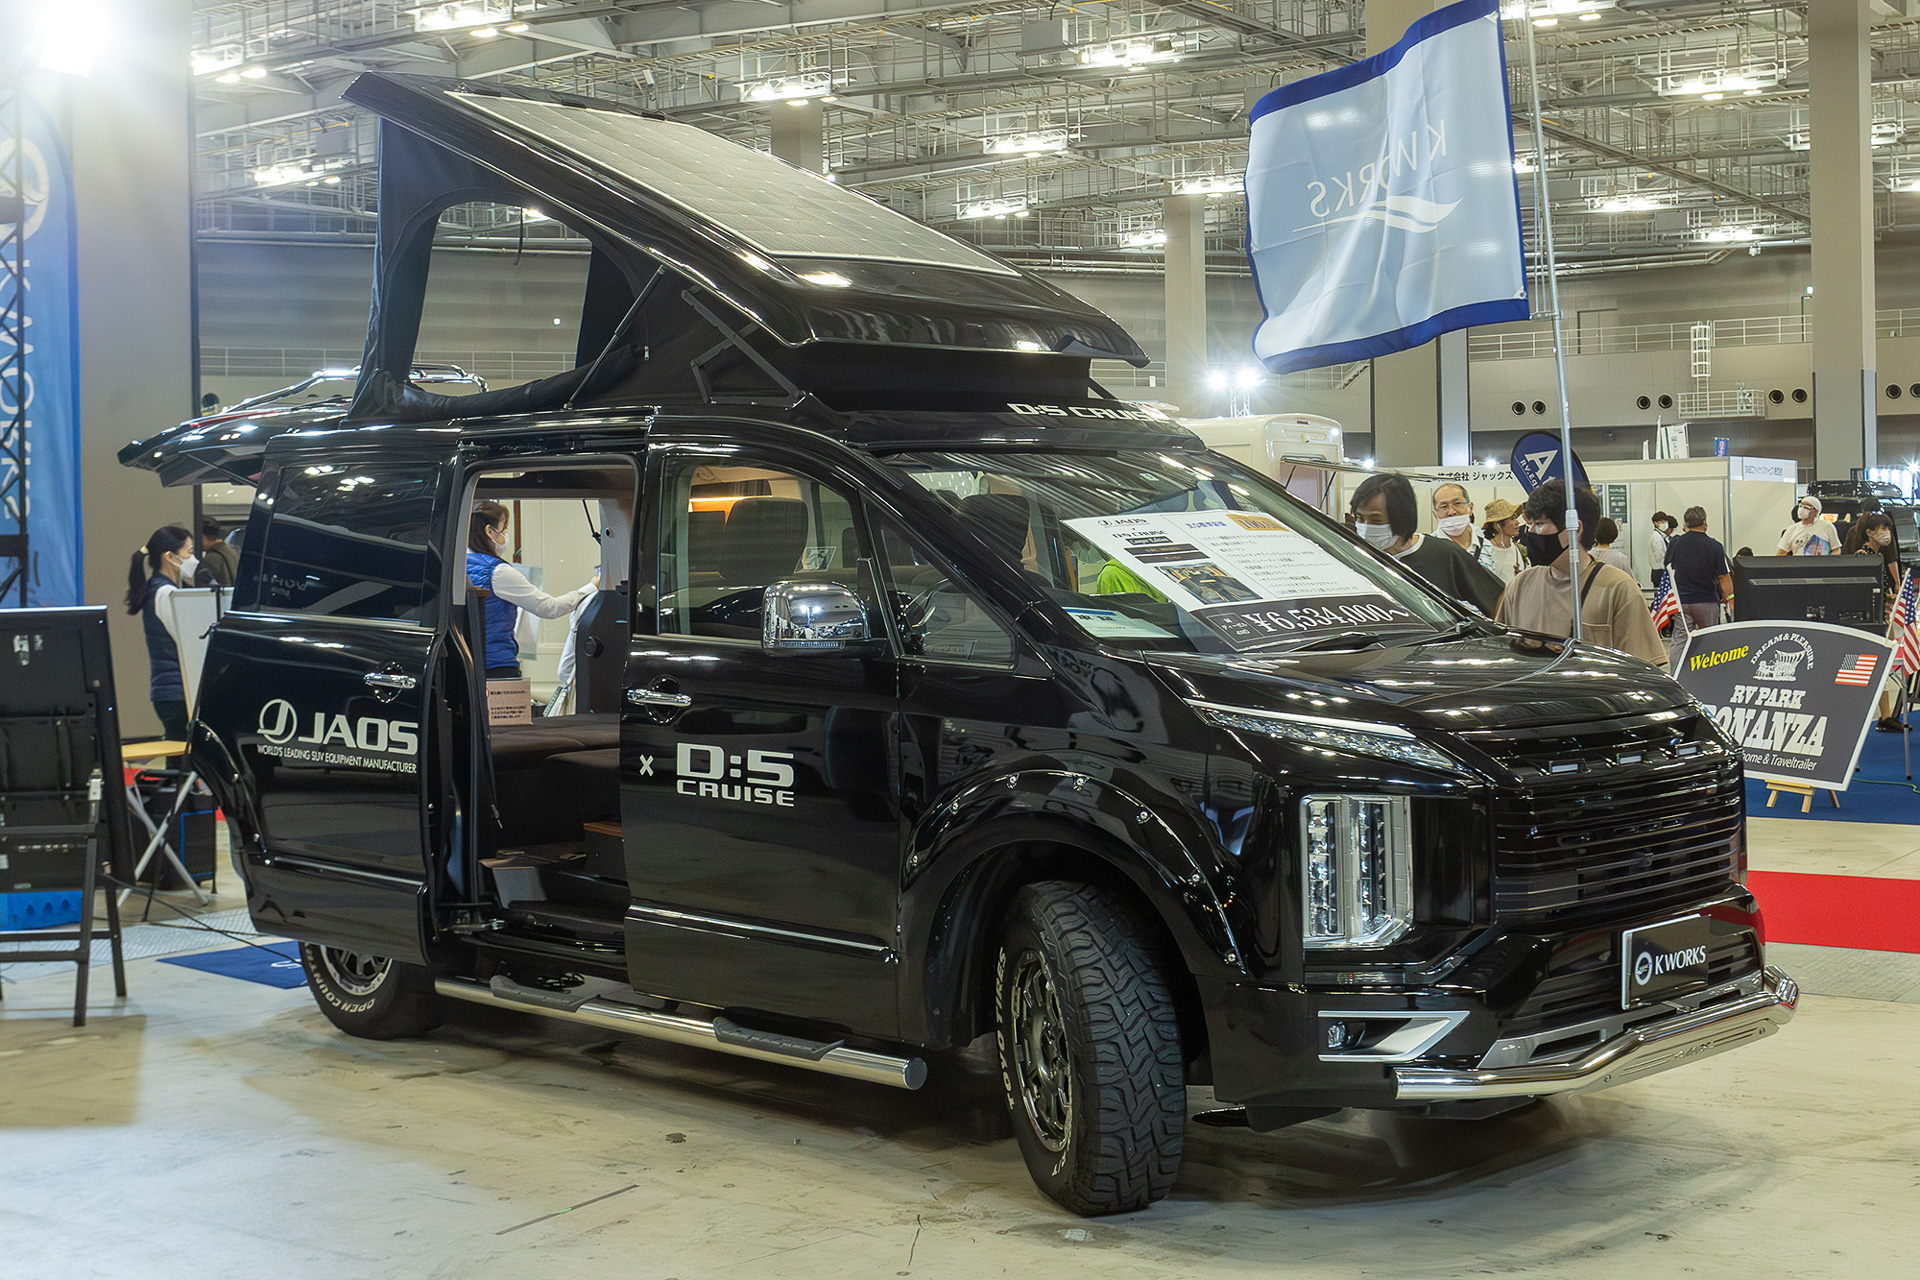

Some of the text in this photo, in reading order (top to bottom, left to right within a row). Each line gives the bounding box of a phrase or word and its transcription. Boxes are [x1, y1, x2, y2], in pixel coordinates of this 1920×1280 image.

[1007, 402, 1170, 423] D:5 CRUIS
[1472, 470, 1513, 481] ジャックス
[1690, 644, 1749, 672] Welcome
[1750, 632, 1814, 670] DREAM & PLEASURE
[1729, 684, 1807, 710] RV PARK
[298, 712, 418, 755] JAOS
[284, 747, 311, 761] LEADING
[311, 750, 326, 762] SUV
[325, 752, 363, 767] EQUIPMENT
[363, 756, 417, 774] MANUFACTURER
[677, 742, 794, 787] D:5
[1762, 753, 1770, 765] &
[1771, 754, 1817, 771] Traveltrailer
[677, 779, 794, 807] CRUISE
[304, 941, 375, 1013] OPEN COUNTR
[995, 946, 1014, 1110] TOYO TIRES
